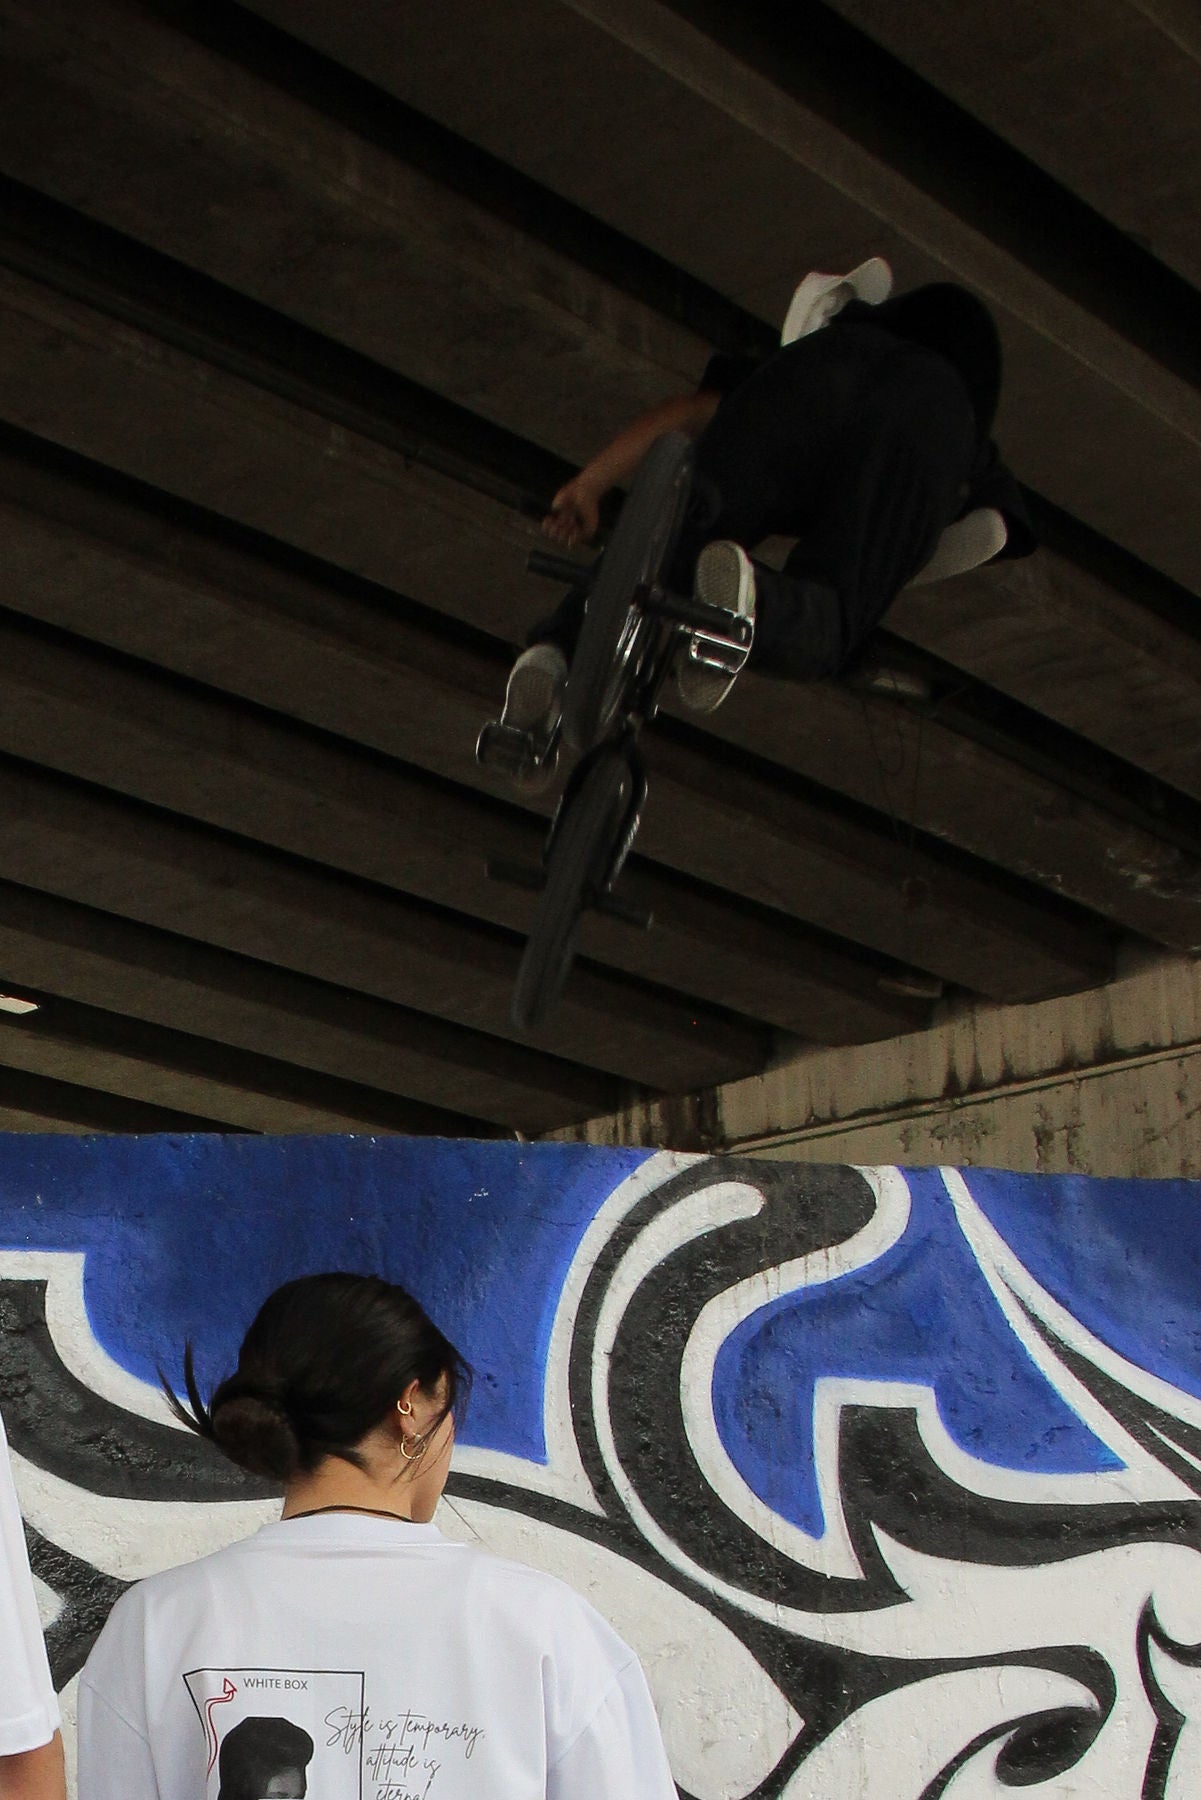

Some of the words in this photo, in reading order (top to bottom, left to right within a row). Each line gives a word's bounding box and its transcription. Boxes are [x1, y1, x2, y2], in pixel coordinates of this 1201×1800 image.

[243, 1677, 282, 1690] WHITE
[284, 1678, 308, 1690] BOX
[324, 1705, 374, 1755] Style
[378, 1718, 398, 1740] is
[365, 1743, 419, 1781] attitude
[423, 1760, 441, 1780] is
